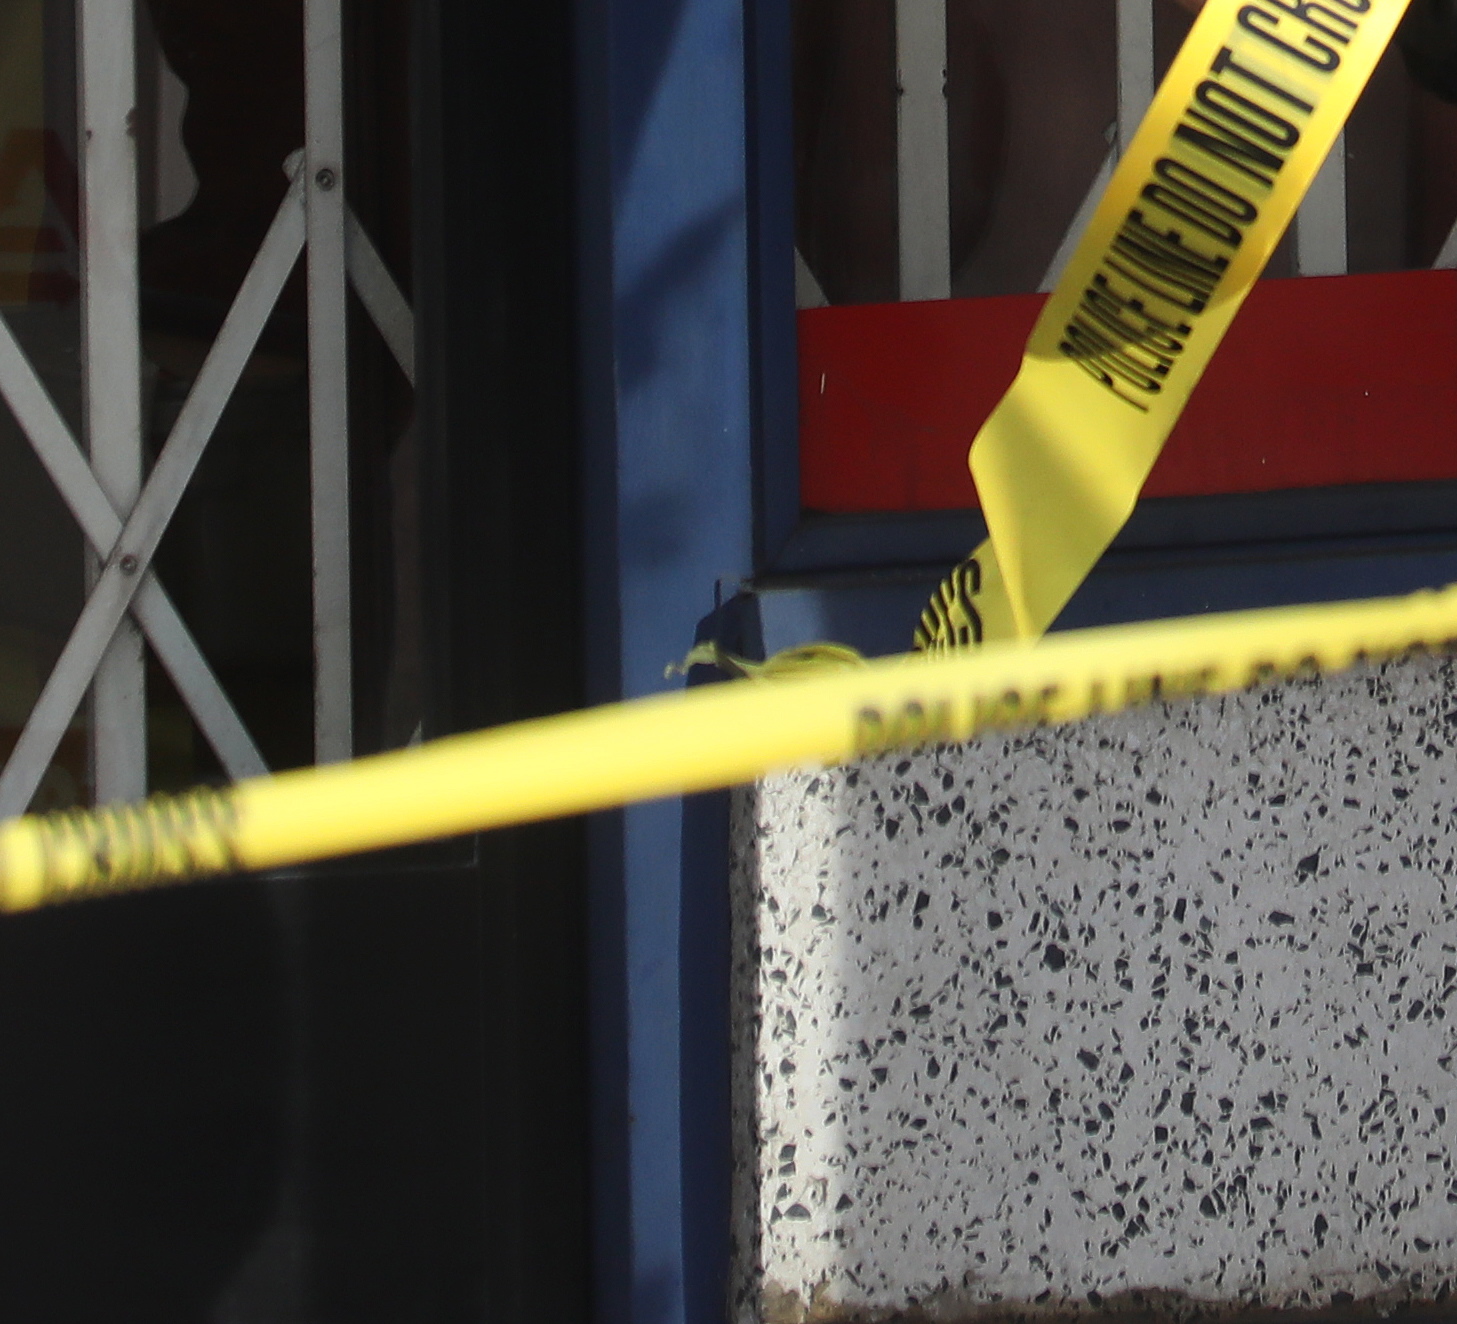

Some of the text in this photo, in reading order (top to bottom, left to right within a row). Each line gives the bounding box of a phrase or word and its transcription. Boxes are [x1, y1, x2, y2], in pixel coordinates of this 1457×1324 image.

[1170, 46, 1317, 190] NOT
[1105, 210, 1230, 317] LINE
[1139, 158, 1258, 246] DO
[1058, 272, 1194, 414] POLICE
